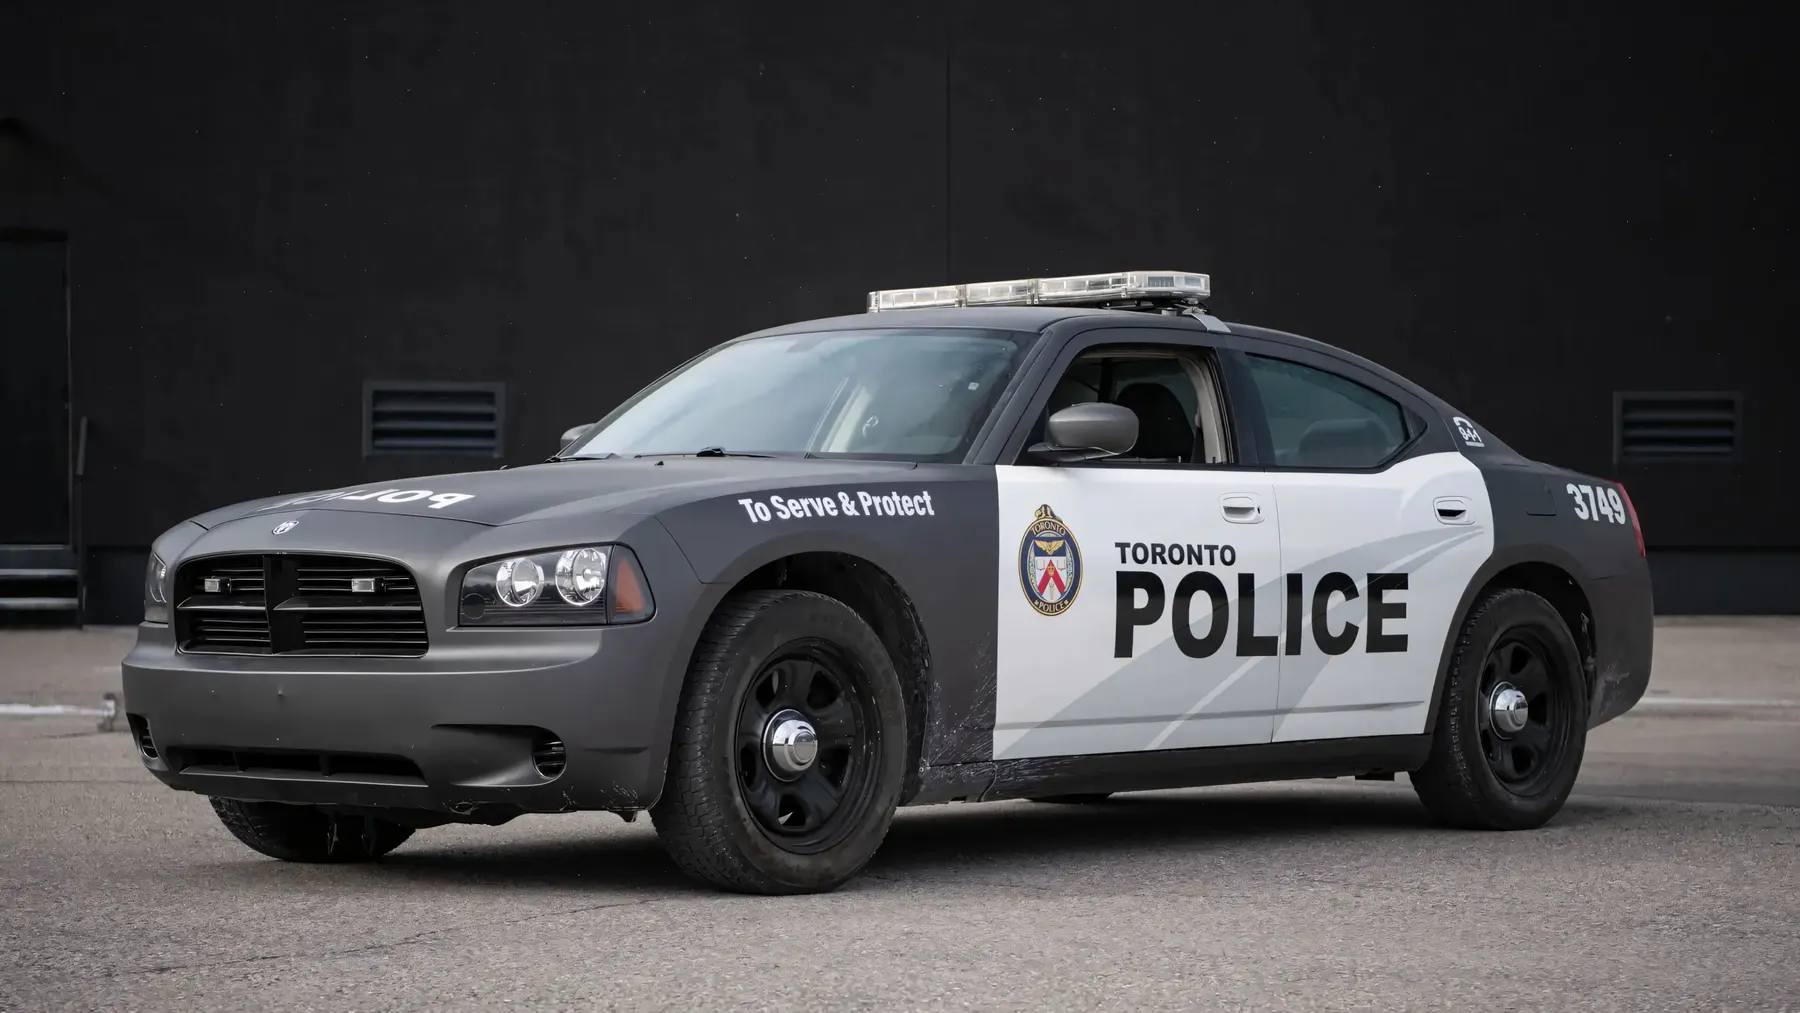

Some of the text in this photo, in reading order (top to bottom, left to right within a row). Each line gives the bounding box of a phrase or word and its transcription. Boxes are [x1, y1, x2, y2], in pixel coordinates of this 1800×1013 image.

[738, 490, 935, 523] To Serve & Protect
[1566, 483, 1626, 525] 3749
[1031, 521, 1066, 536] TORONTO
[1115, 542, 1236, 566] TORONTO
[1038, 601, 1064, 613] POLICE
[1114, 570, 1409, 659] POLICE
